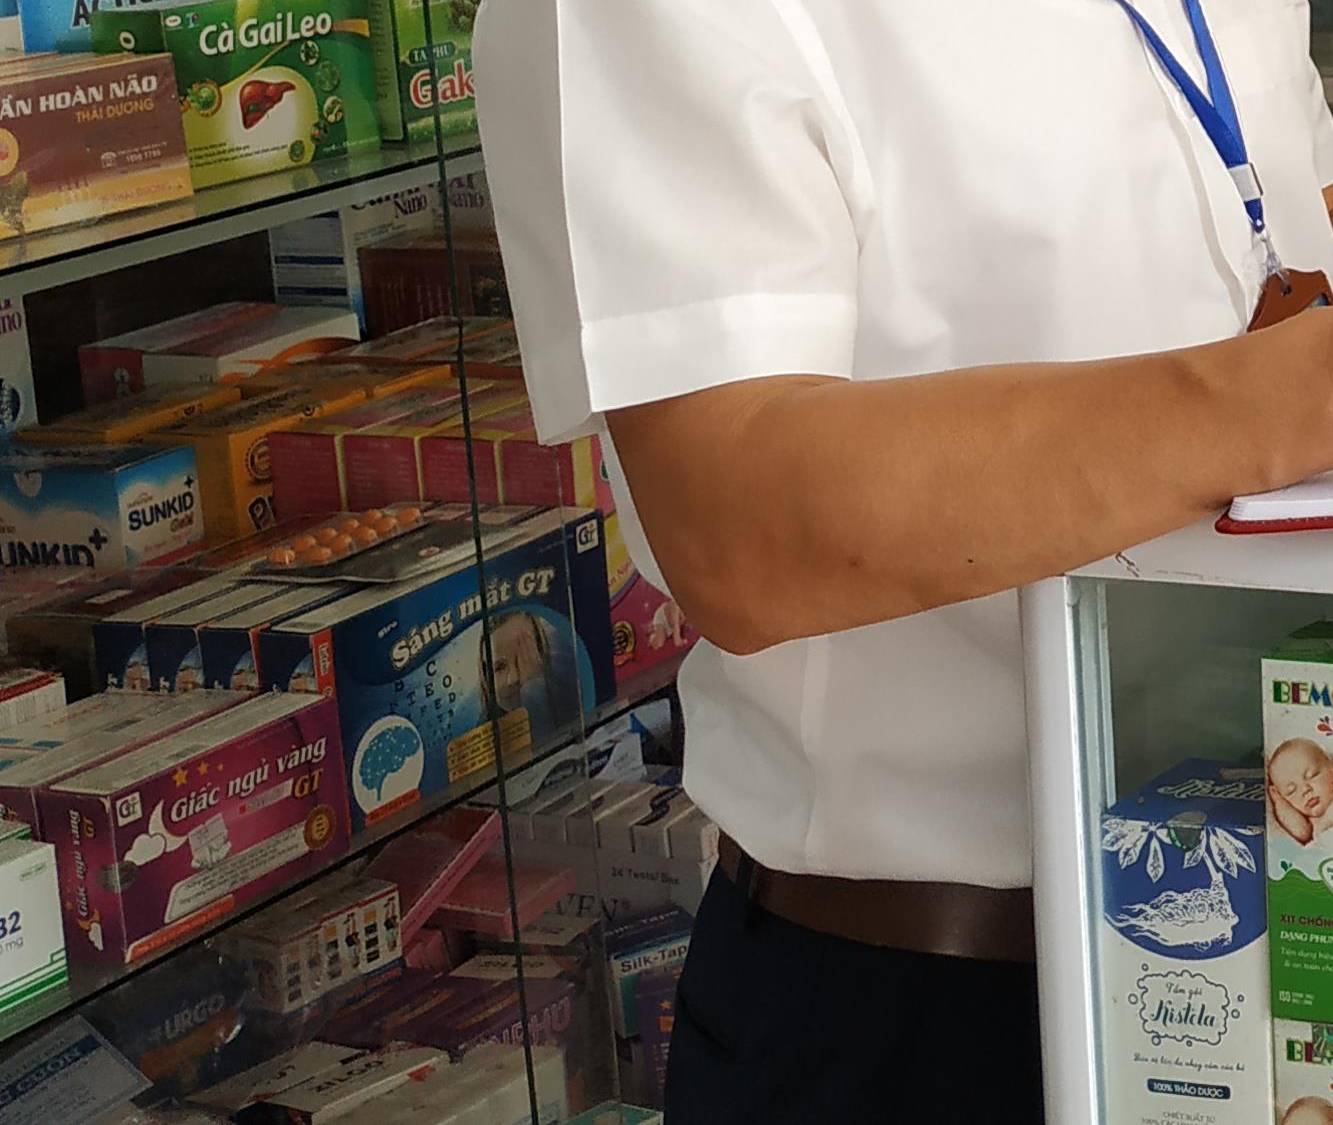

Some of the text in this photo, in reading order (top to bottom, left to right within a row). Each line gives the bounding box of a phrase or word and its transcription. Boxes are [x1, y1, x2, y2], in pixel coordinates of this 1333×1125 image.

[199, 21, 235, 56] Cà
[40, 74, 159, 112] HOÀN NÃO
[128, 492, 195, 532] SUNKID
[391, 568, 555, 670] Sáng mắt GT
[170, 737, 328, 824] Giấc ngủ vàng
[293, 768, 324, 799] GT
[620, 941, 688, 974] Silk-Tap
[1153, 1081, 1224, 1098] 100% THẢO DƯỢC
